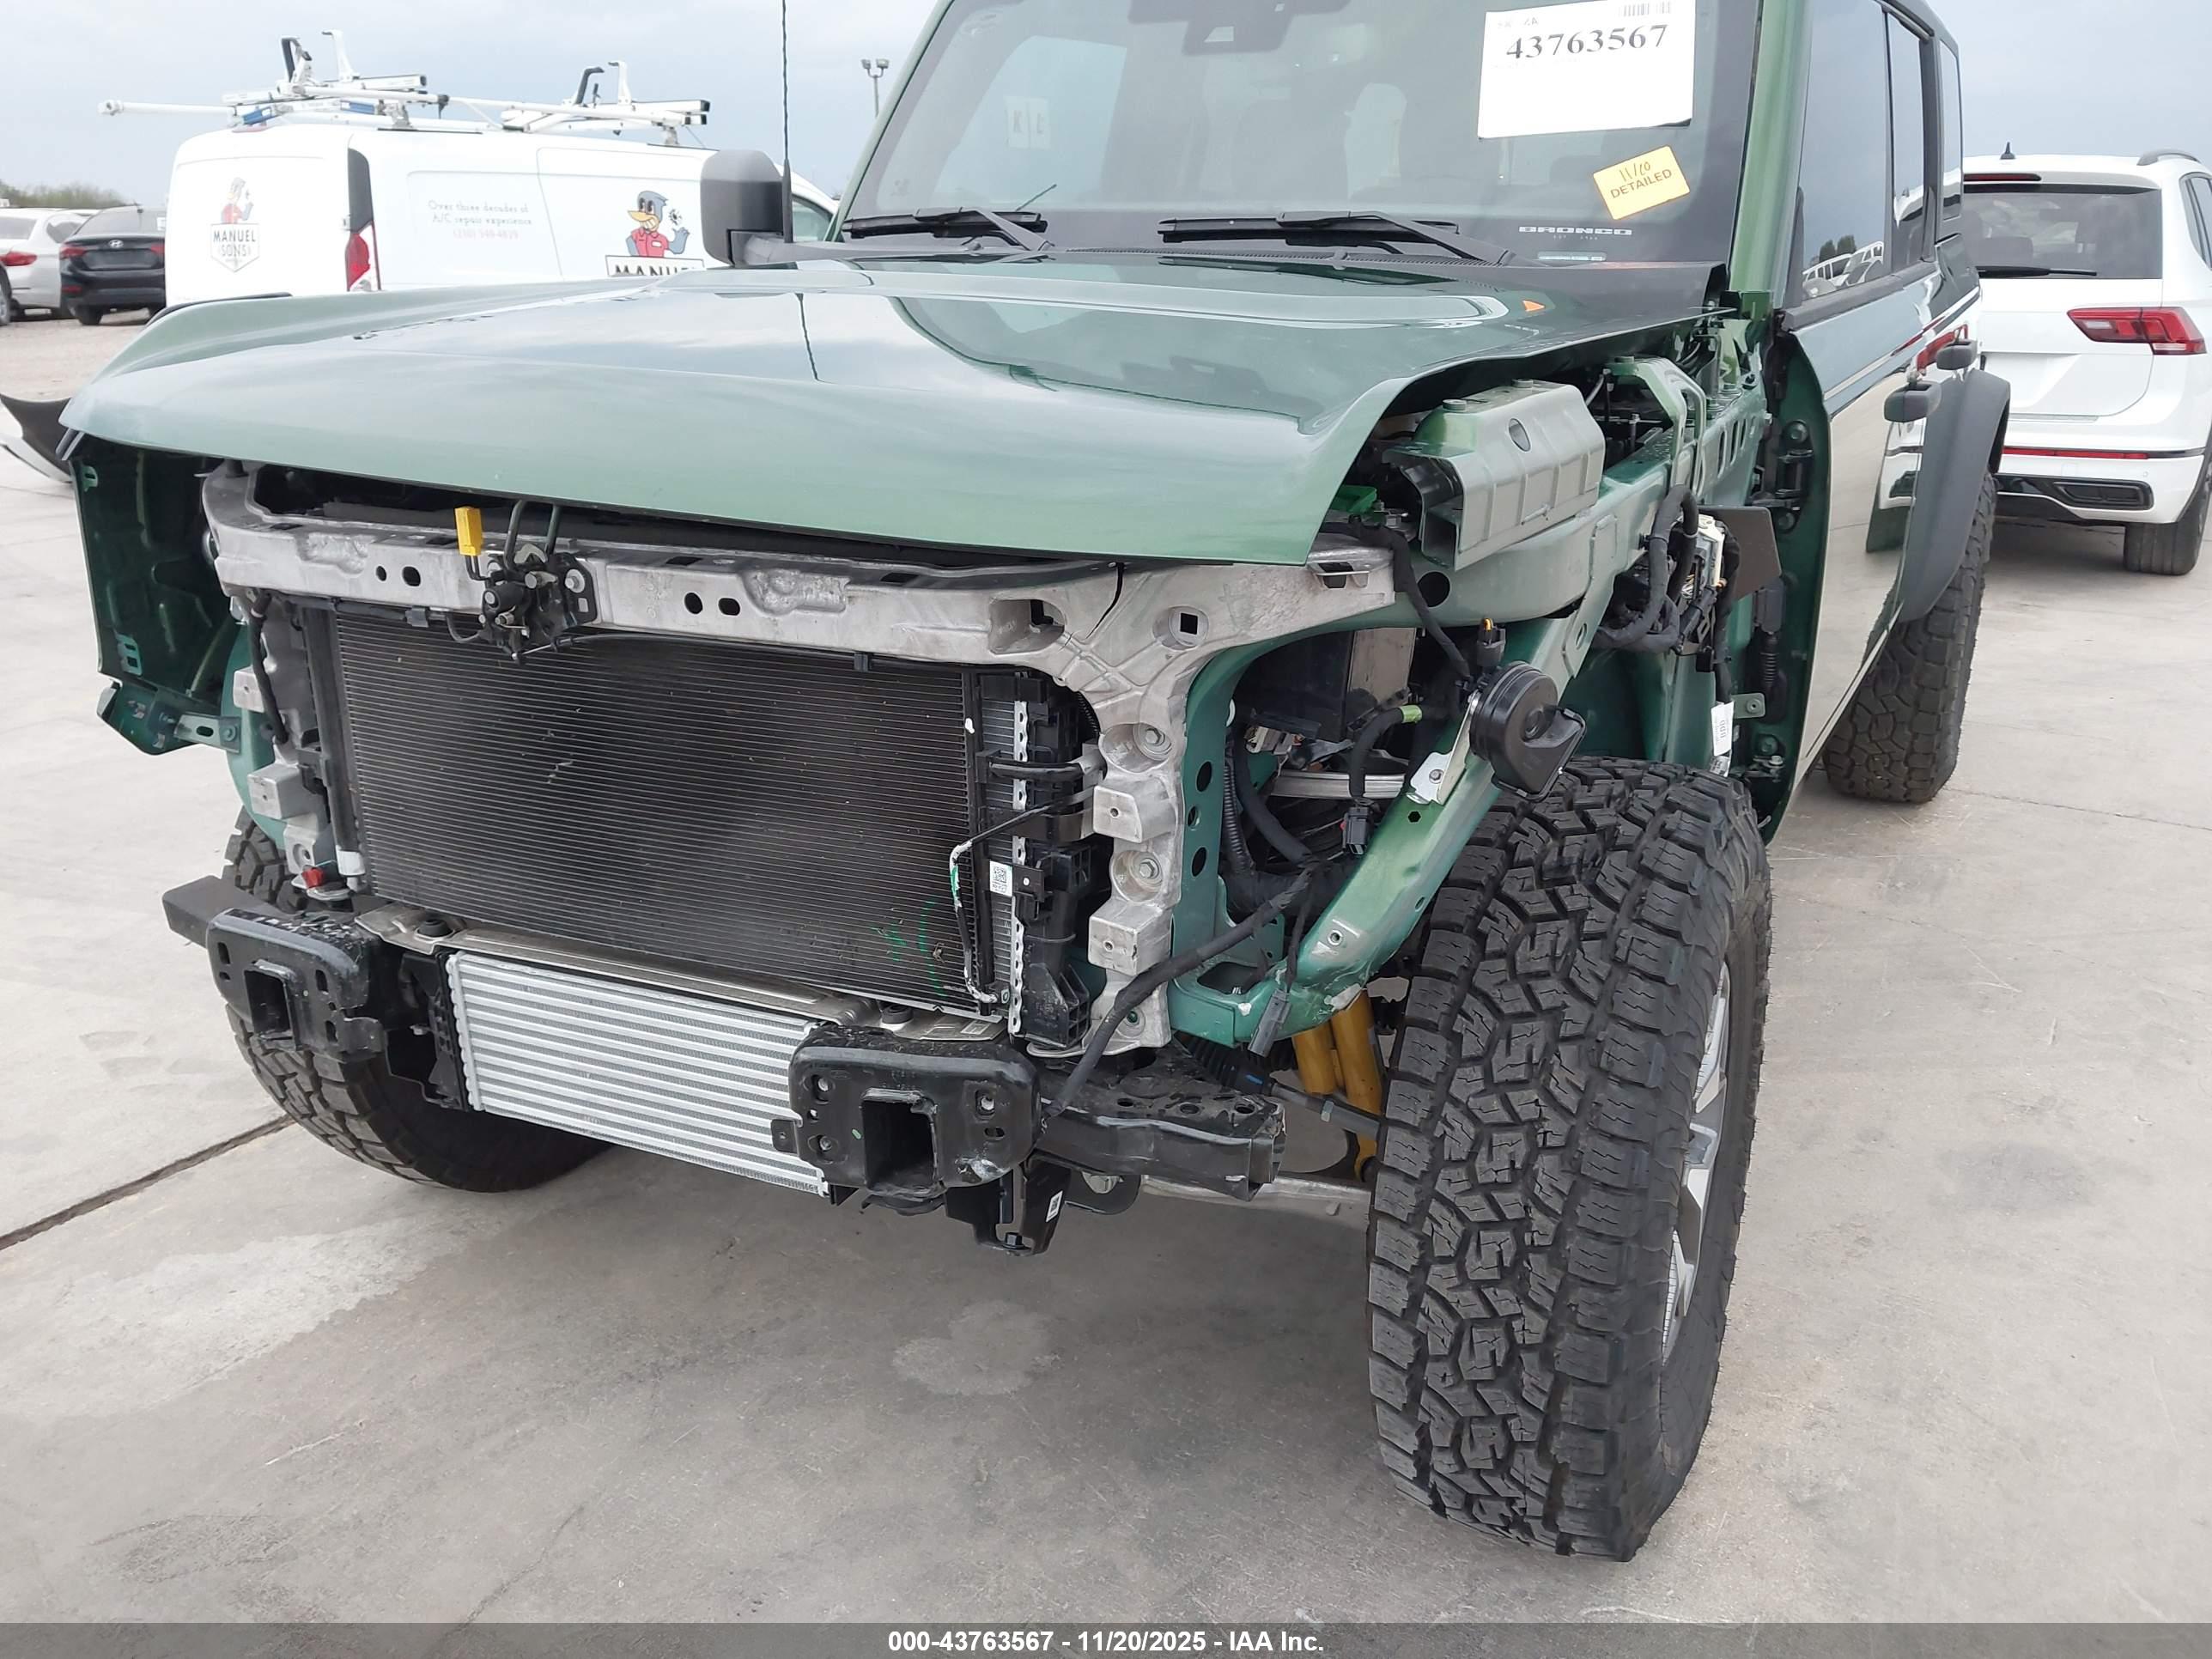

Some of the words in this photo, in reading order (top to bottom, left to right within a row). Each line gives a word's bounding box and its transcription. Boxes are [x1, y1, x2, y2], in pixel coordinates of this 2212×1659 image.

[1505, 24, 1669, 59] 43763567
[1610, 168, 1673, 198] DETAILED
[428, 199, 453, 210] Over
[455, 199, 480, 211] three
[212, 229, 257, 242] MANUEL
[1518, 225, 1633, 235] BRONCO
[221, 243, 247, 258] SONS
